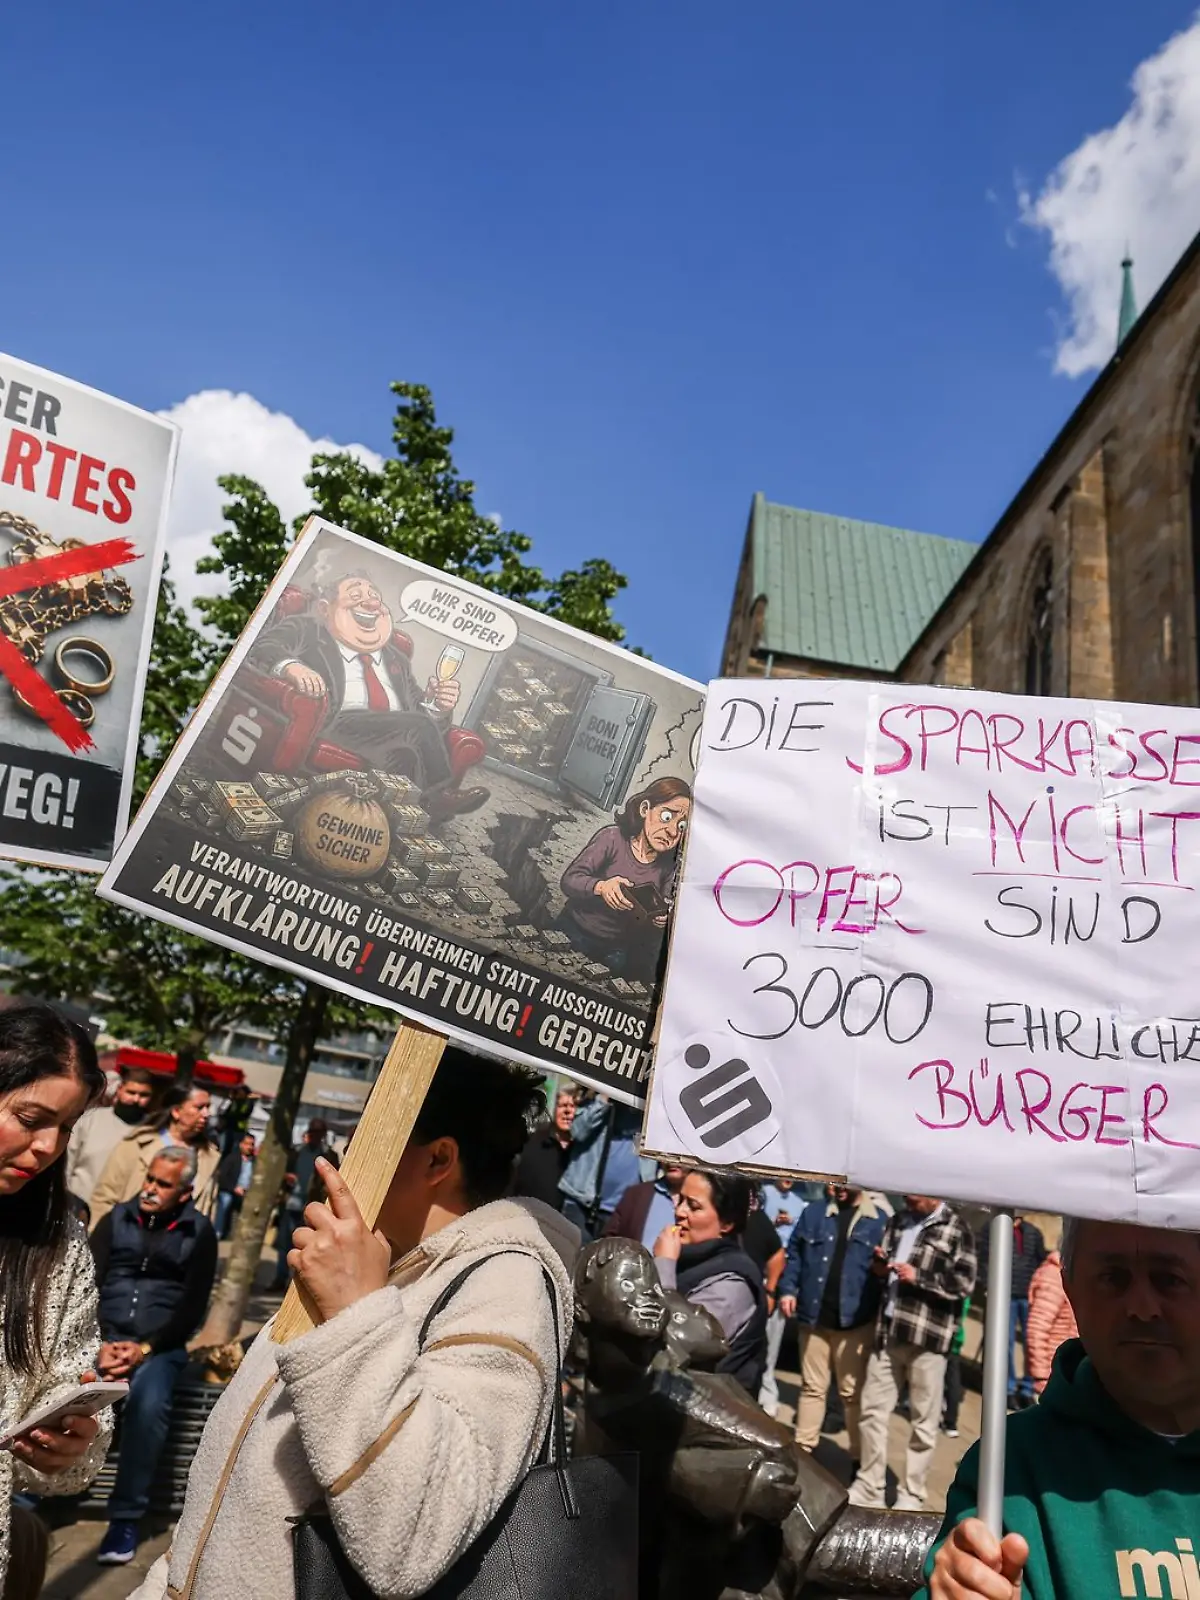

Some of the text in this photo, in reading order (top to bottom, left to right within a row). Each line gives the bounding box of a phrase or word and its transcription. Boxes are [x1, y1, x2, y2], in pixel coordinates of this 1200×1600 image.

[0, 376, 61, 436] ER
[2, 428, 136, 524] RTES
[407, 599, 505, 646] AUCH OPFER!
[431, 588, 497, 624] WIR SIND
[576, 731, 617, 761] SICHER
[587, 715, 619, 740] BONI
[846, 704, 1200, 786] SPARKASSE
[316, 834, 371, 865] SICHER
[317, 812, 384, 847] GEWINNE
[713, 860, 927, 934] OPFER
[152, 863, 374, 975] AUFKLÄRUNG!
[378, 951, 532, 1037] HAFTUNG!
[190, 840, 647, 1040] VERANTWORTUNG ÜBERNEHMEN STATT AUSSCHLUSS
[727, 952, 933, 1044] 3000
[908, 1058, 1200, 1148] BÜRGER
[1115, 1537, 1200, 1600] mi
